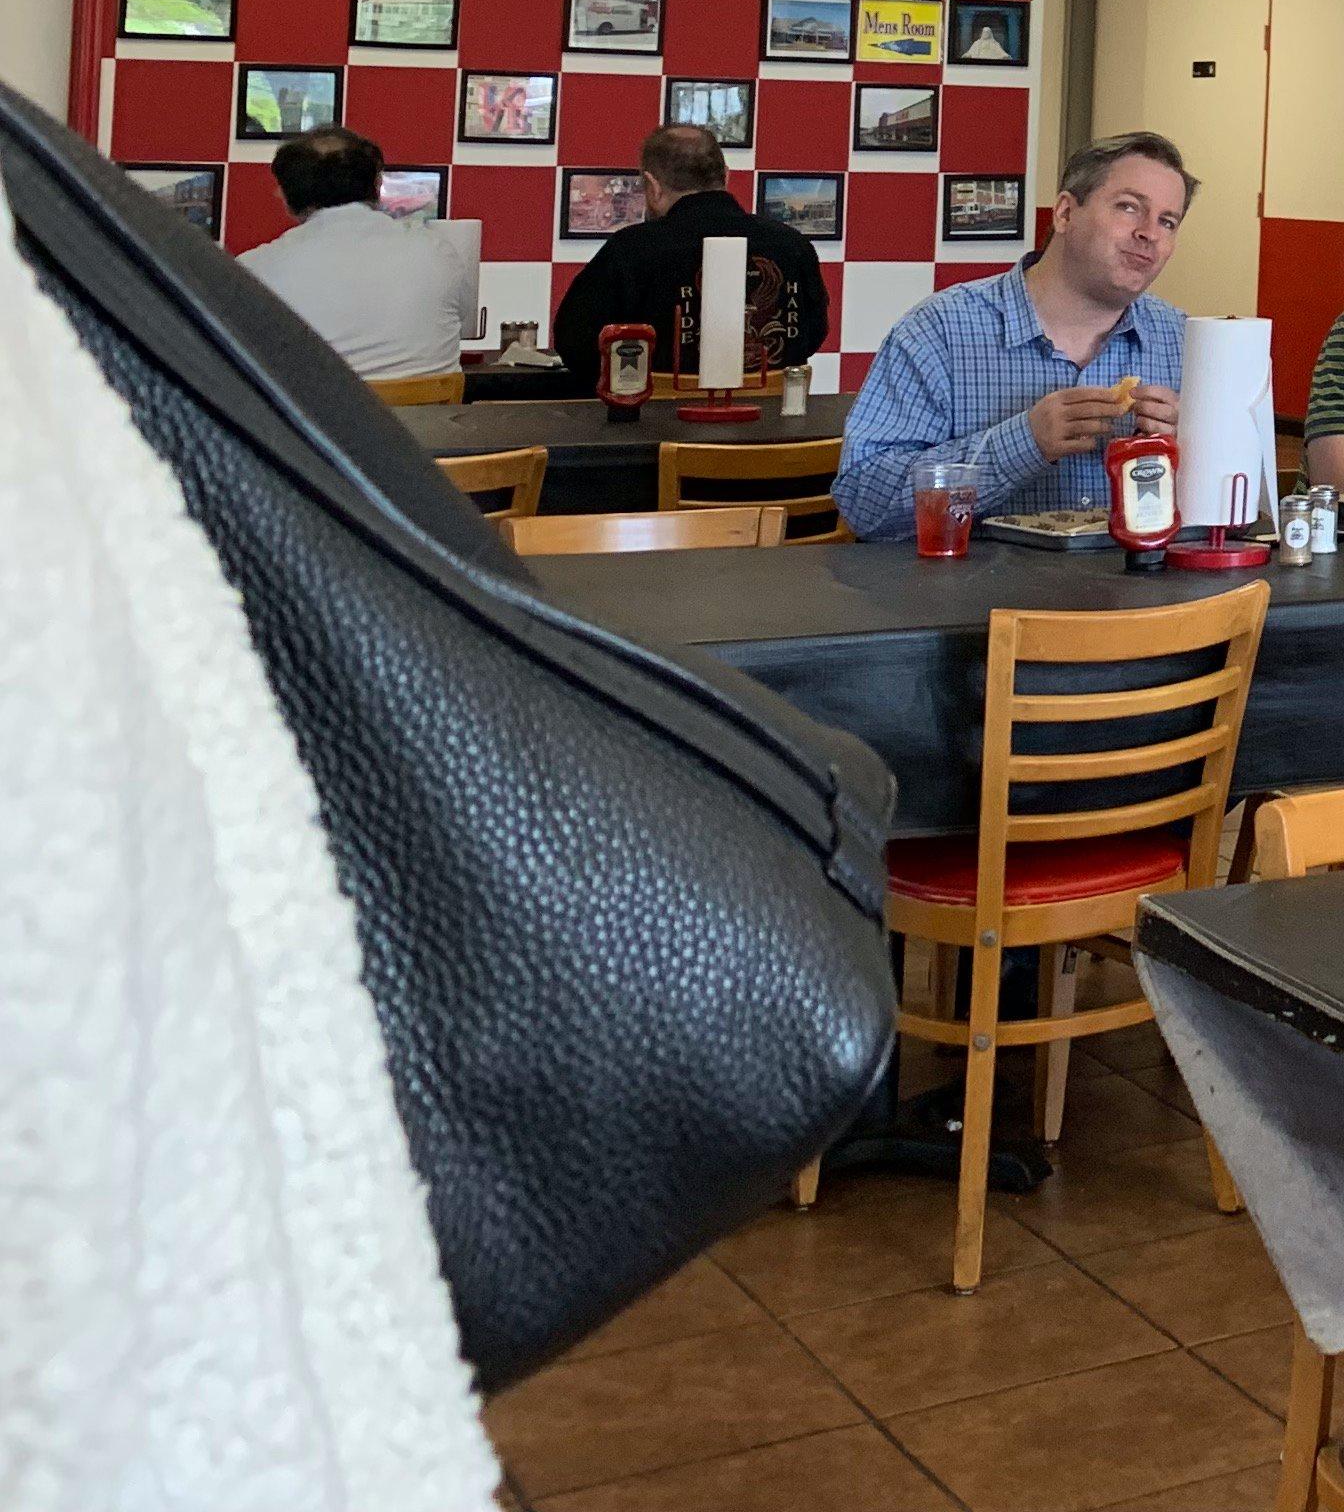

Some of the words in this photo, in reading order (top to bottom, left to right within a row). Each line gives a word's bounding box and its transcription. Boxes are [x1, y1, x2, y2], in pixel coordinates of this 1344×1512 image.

[863, 11, 898, 36] Mens
[902, 14, 936, 38] Room
[680, 286, 694, 344] RIDE
[786, 282, 799, 338] HARD
[1132, 468, 1165, 478] CROWN
